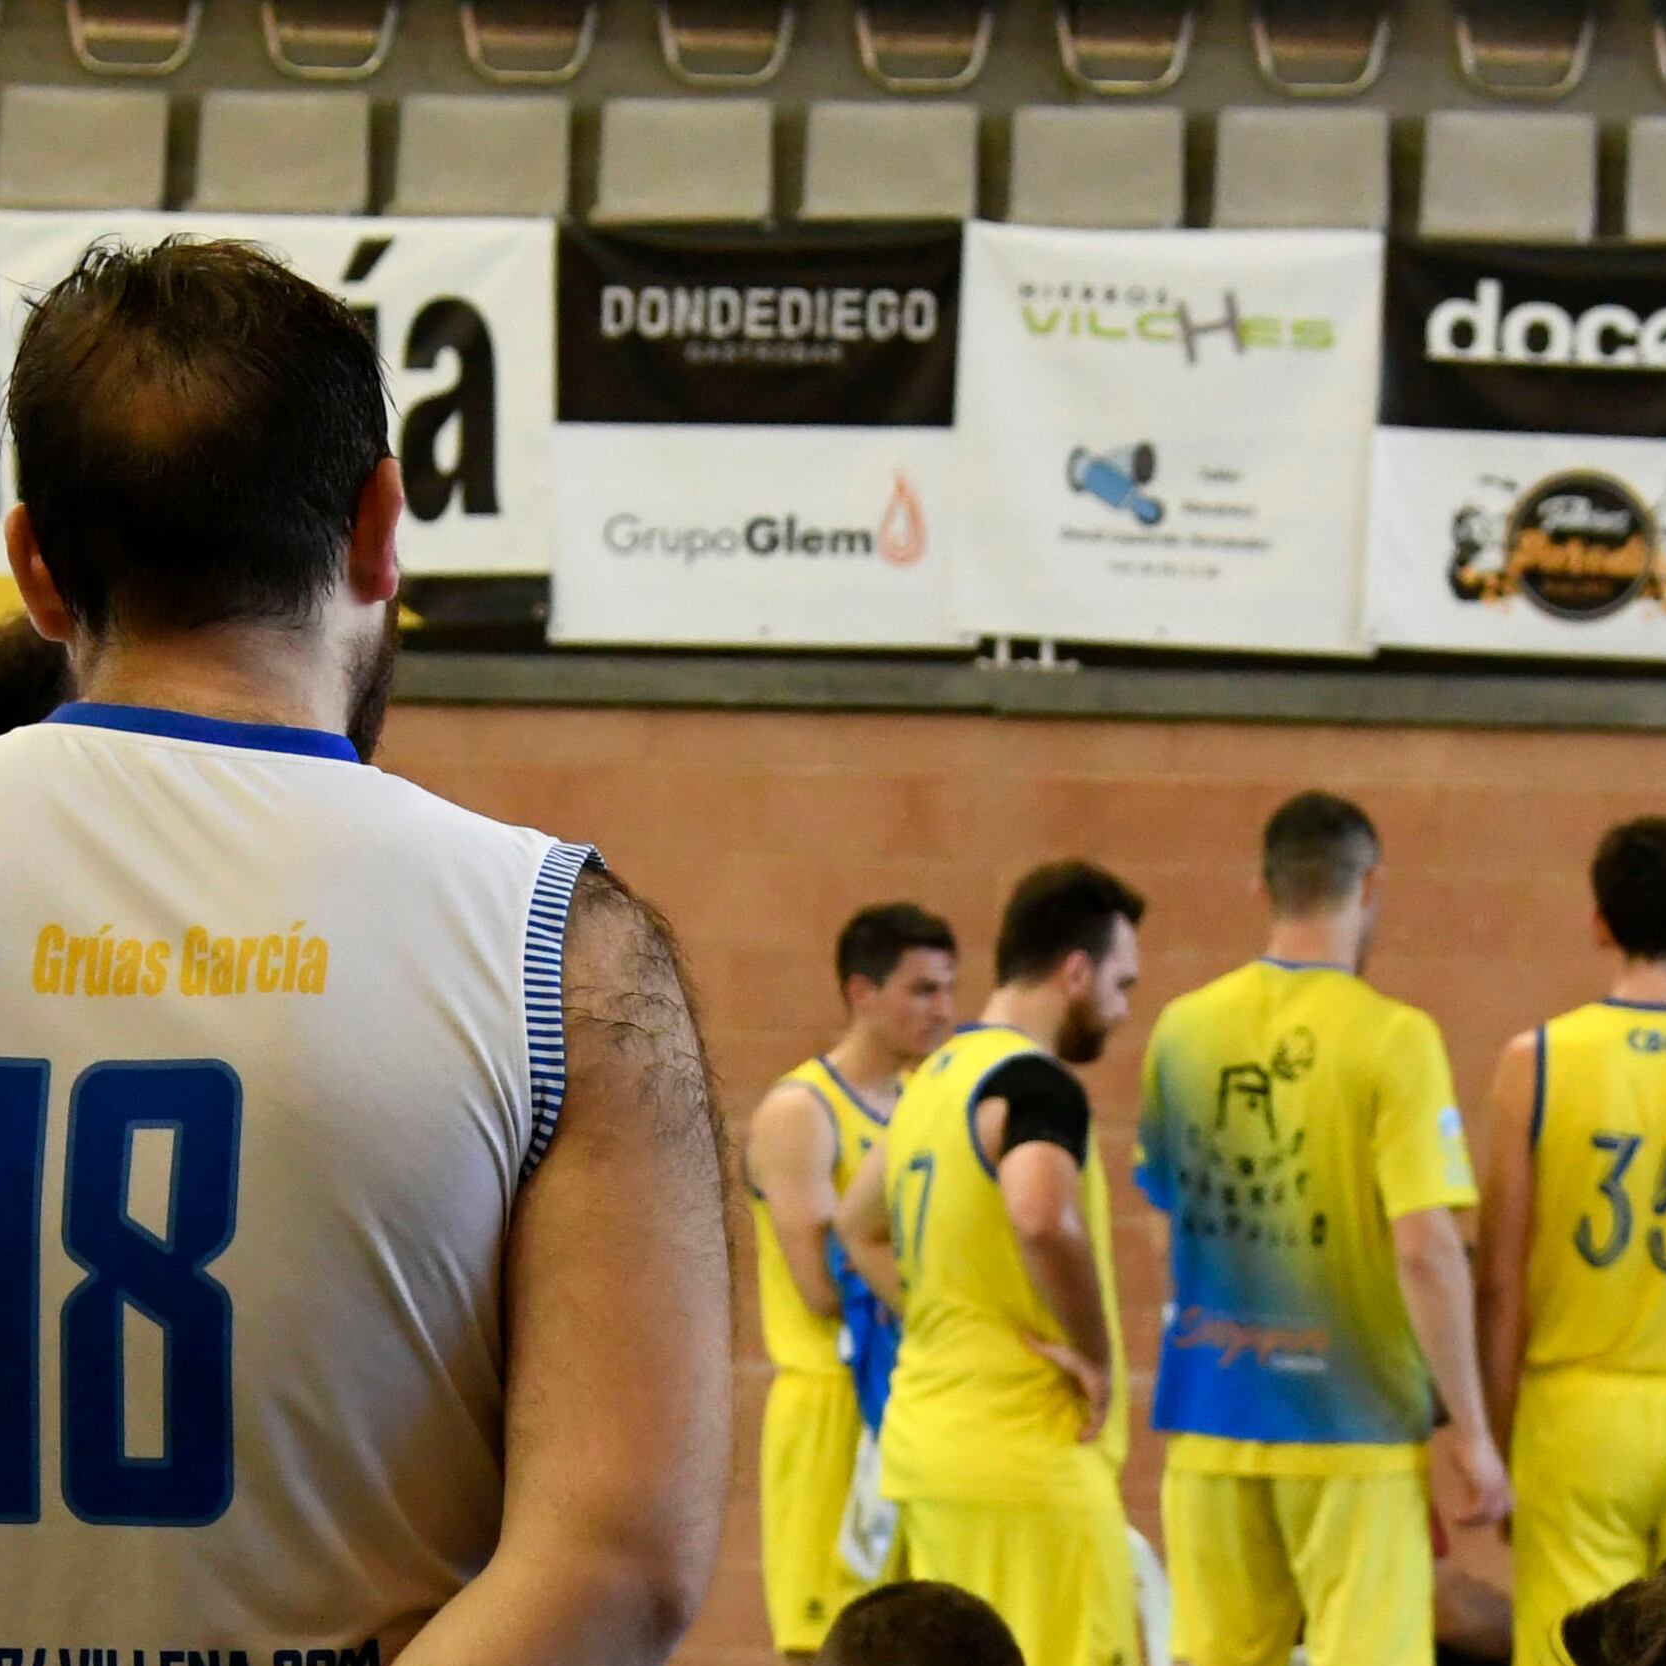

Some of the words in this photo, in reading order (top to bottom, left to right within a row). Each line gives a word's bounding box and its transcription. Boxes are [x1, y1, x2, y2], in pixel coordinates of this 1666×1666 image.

[600, 285, 937, 342] DONDEDIEGO
[1021, 289, 1335, 366] VILCHES
[33, 923, 172, 996] Grúas
[180, 919, 330, 996] García
